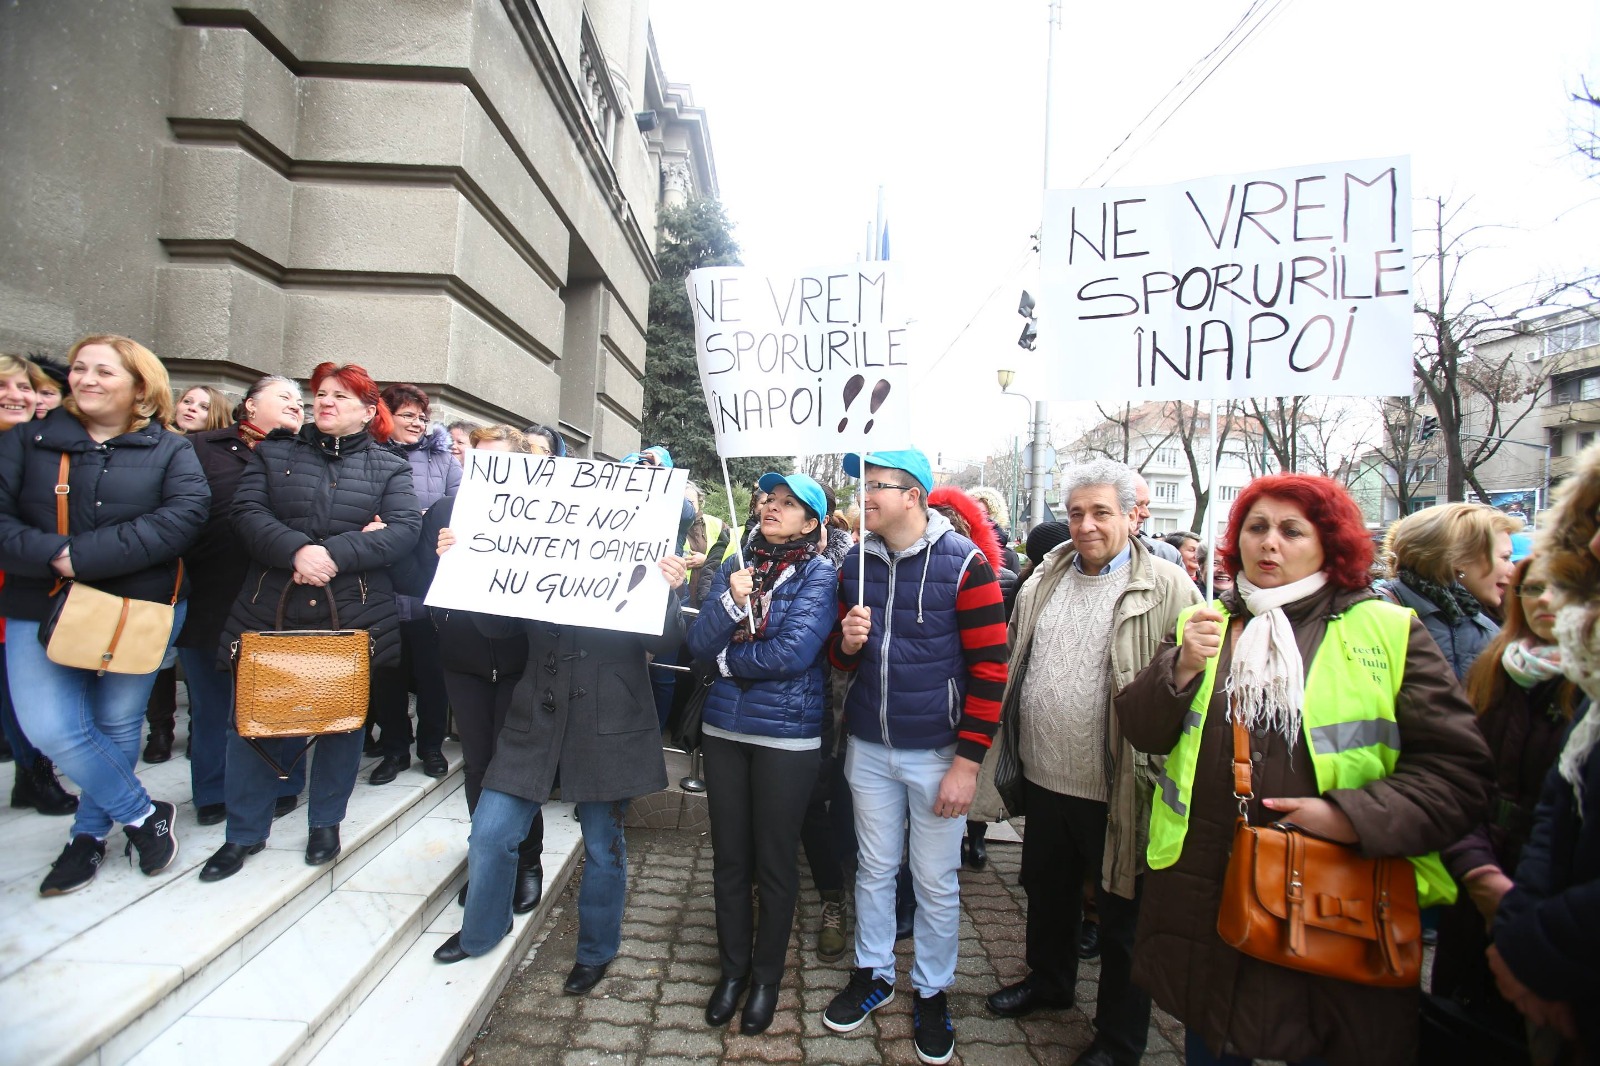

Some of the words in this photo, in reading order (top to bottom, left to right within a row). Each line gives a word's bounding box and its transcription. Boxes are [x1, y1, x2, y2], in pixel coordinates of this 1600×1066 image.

[1068, 198, 1150, 265] NE
[1185, 167, 1397, 250] VREM
[694, 278, 742, 327] NE
[765, 271, 886, 326] VREM
[470, 455, 511, 485] NU
[488, 493, 540, 522] JOC
[545, 500, 580, 525] DE
[469, 533, 581, 561] SUNTEM
[488, 568, 530, 595] NU
